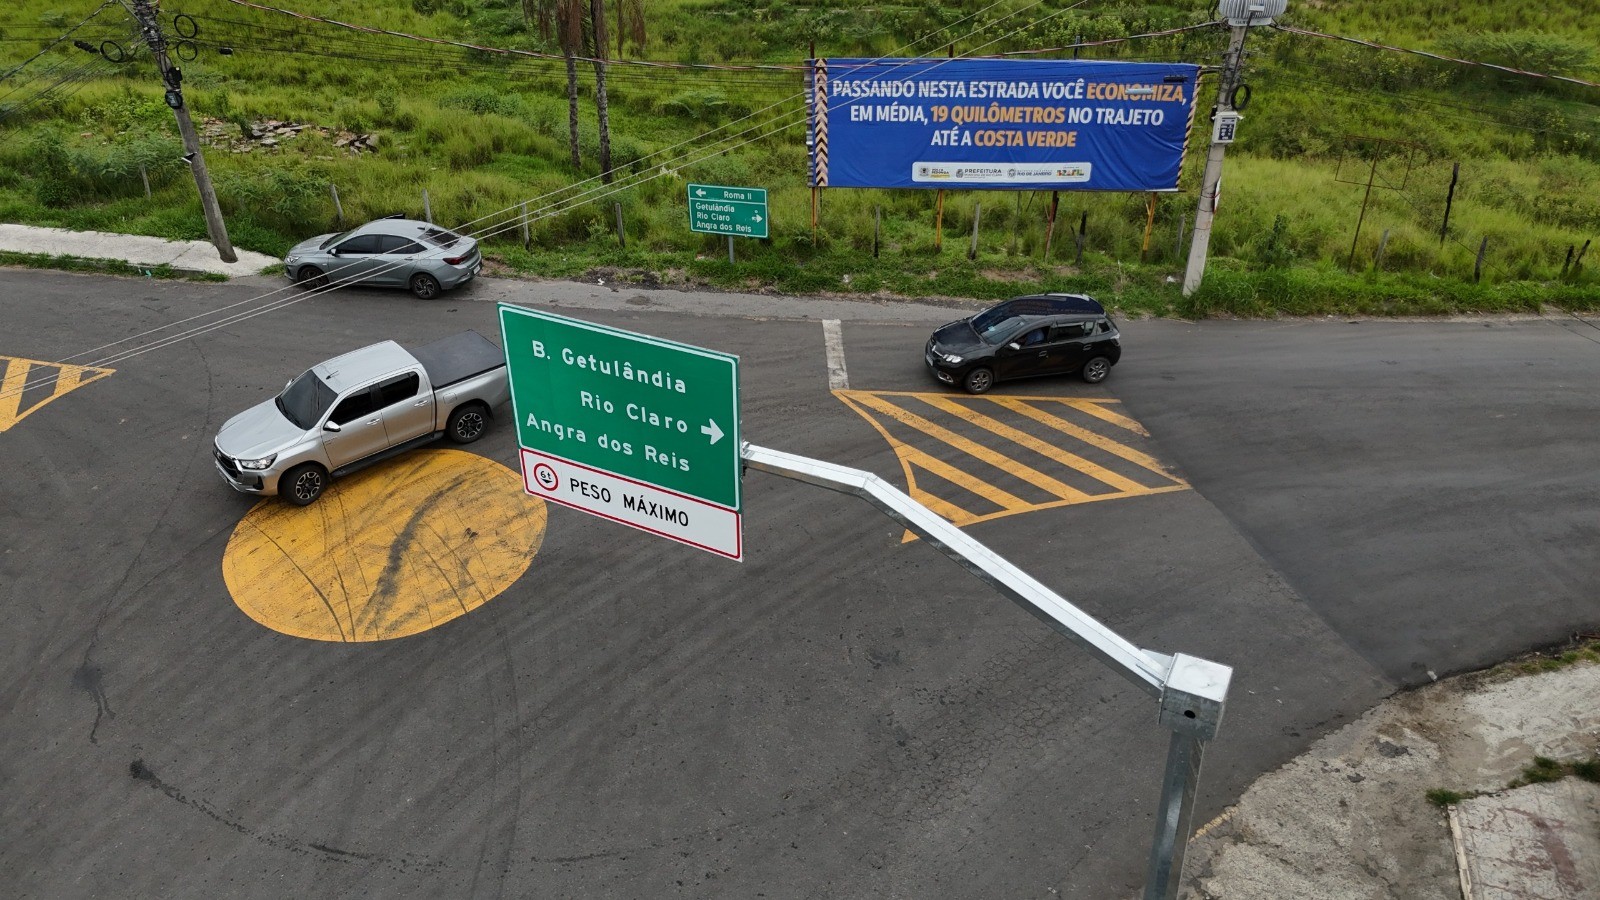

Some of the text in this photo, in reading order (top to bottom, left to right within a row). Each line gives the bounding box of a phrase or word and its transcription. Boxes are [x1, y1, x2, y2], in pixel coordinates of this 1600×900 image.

[833, 78, 1187, 106] PASSANDO NESTA ESTRADA VOCÊ ECONOMIZA,
[850, 102, 1164, 126] EM MÉDIA, 19 QUILÔMETROS NO TRAJETO
[931, 126, 1077, 148] ATÉ A COSTA VERDE
[695, 203, 735, 212] Getulândia
[724, 191, 745, 200] Roma
[696, 211, 730, 221] Rio Claro
[696, 221, 752, 233] Angra dos Reis
[531, 339, 687, 394] B. Getulândia
[580, 390, 689, 434] Rio Claro
[526, 412, 691, 472] Angra dos Reis
[569, 477, 690, 528] PESO MÁXIMO
